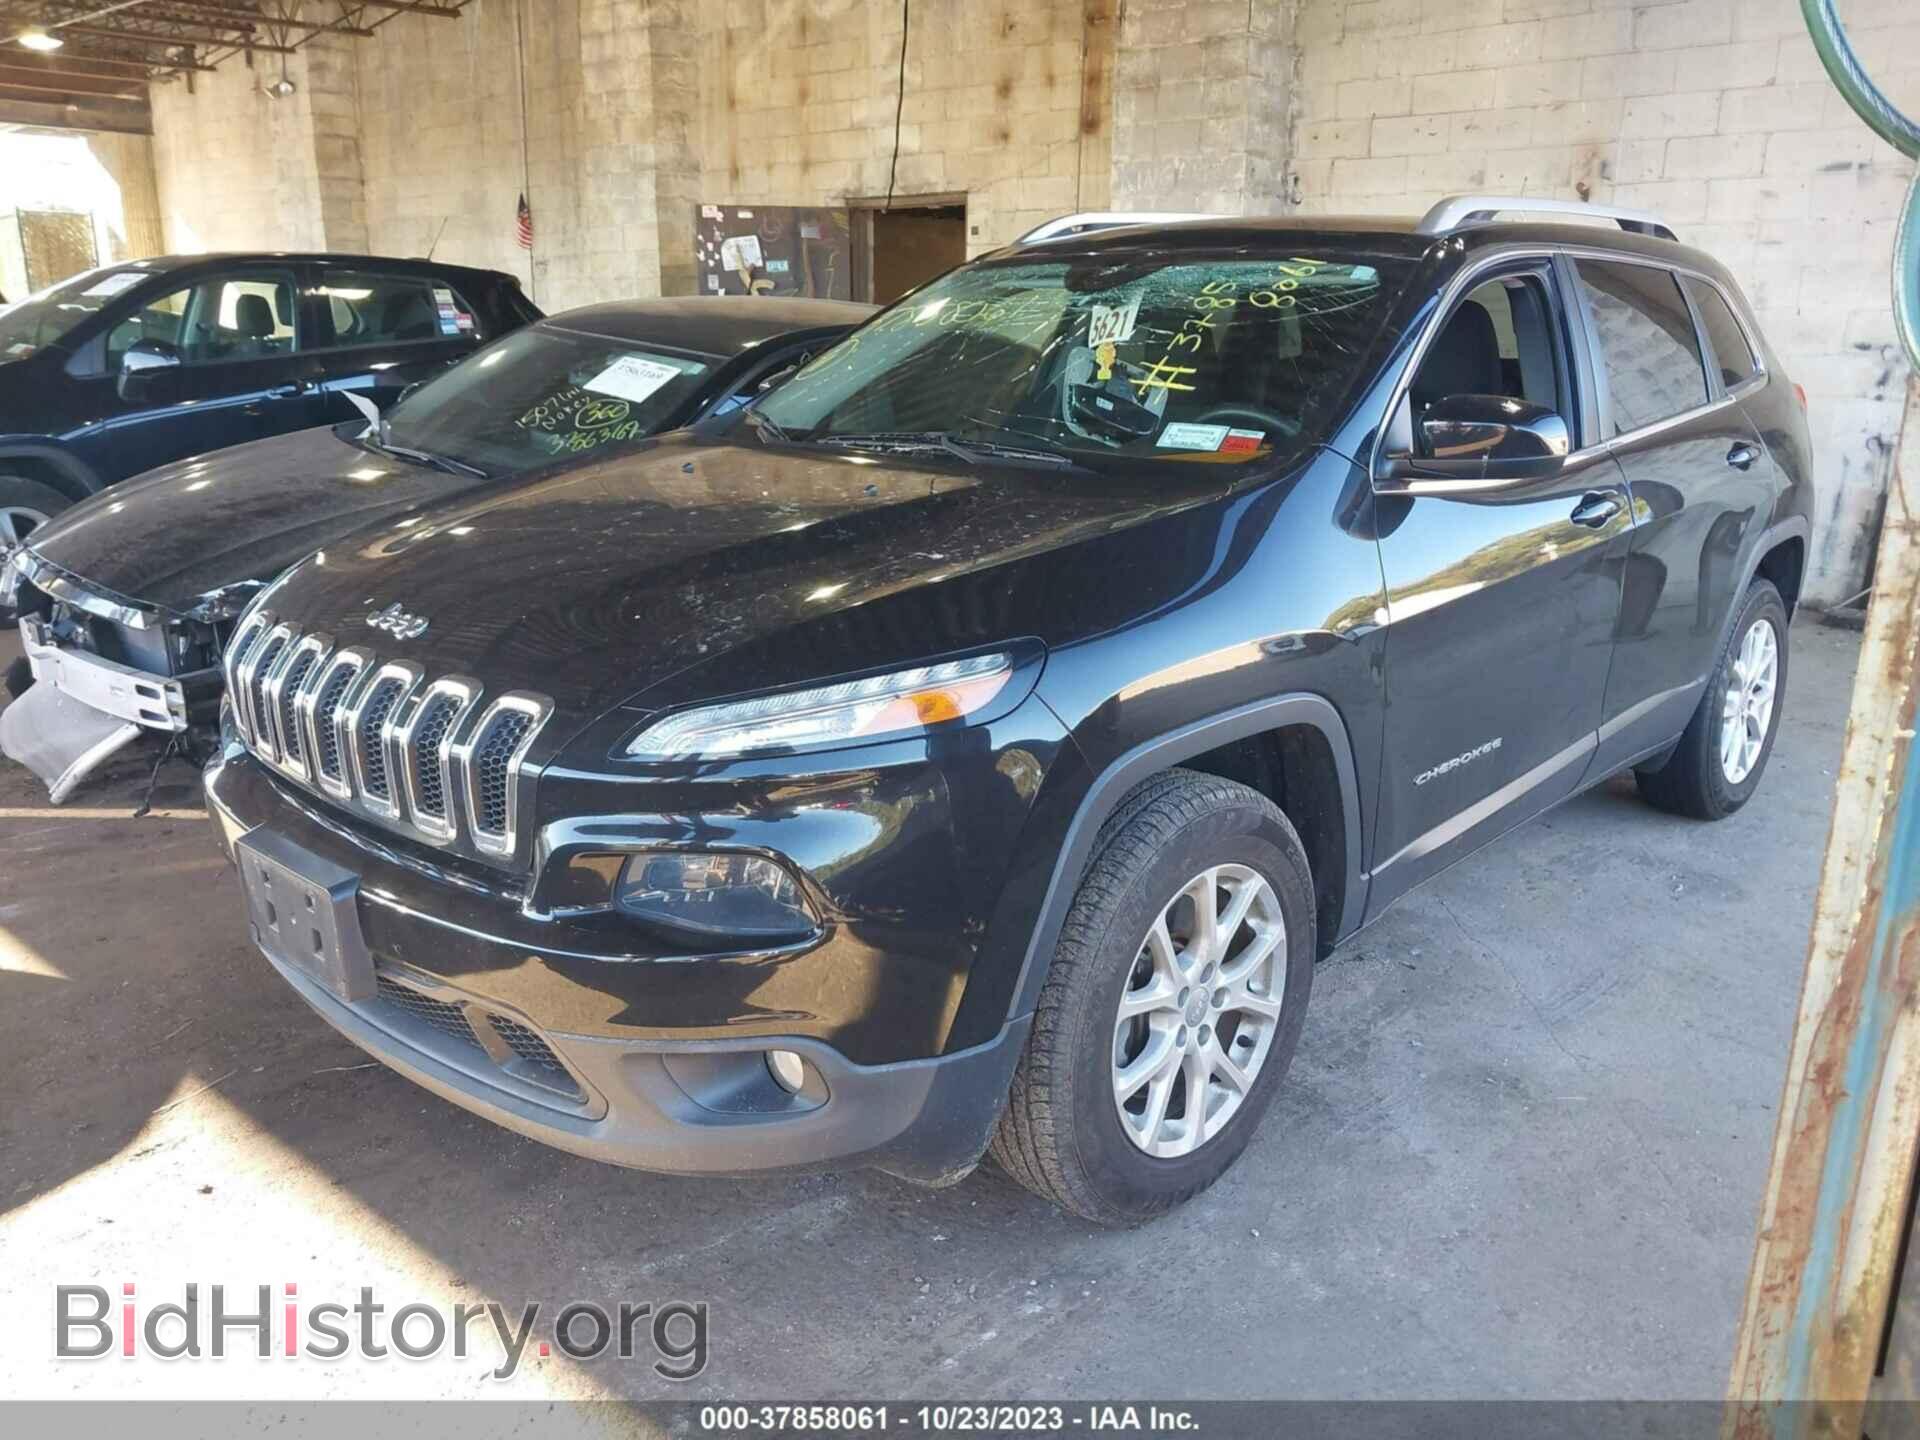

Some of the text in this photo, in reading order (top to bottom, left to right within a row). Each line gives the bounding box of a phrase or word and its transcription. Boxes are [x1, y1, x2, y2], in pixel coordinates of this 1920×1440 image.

[1090, 308, 1131, 345] 5621
[365, 601, 430, 640] Jeep
[1413, 737, 1504, 786] CHEROKEE
